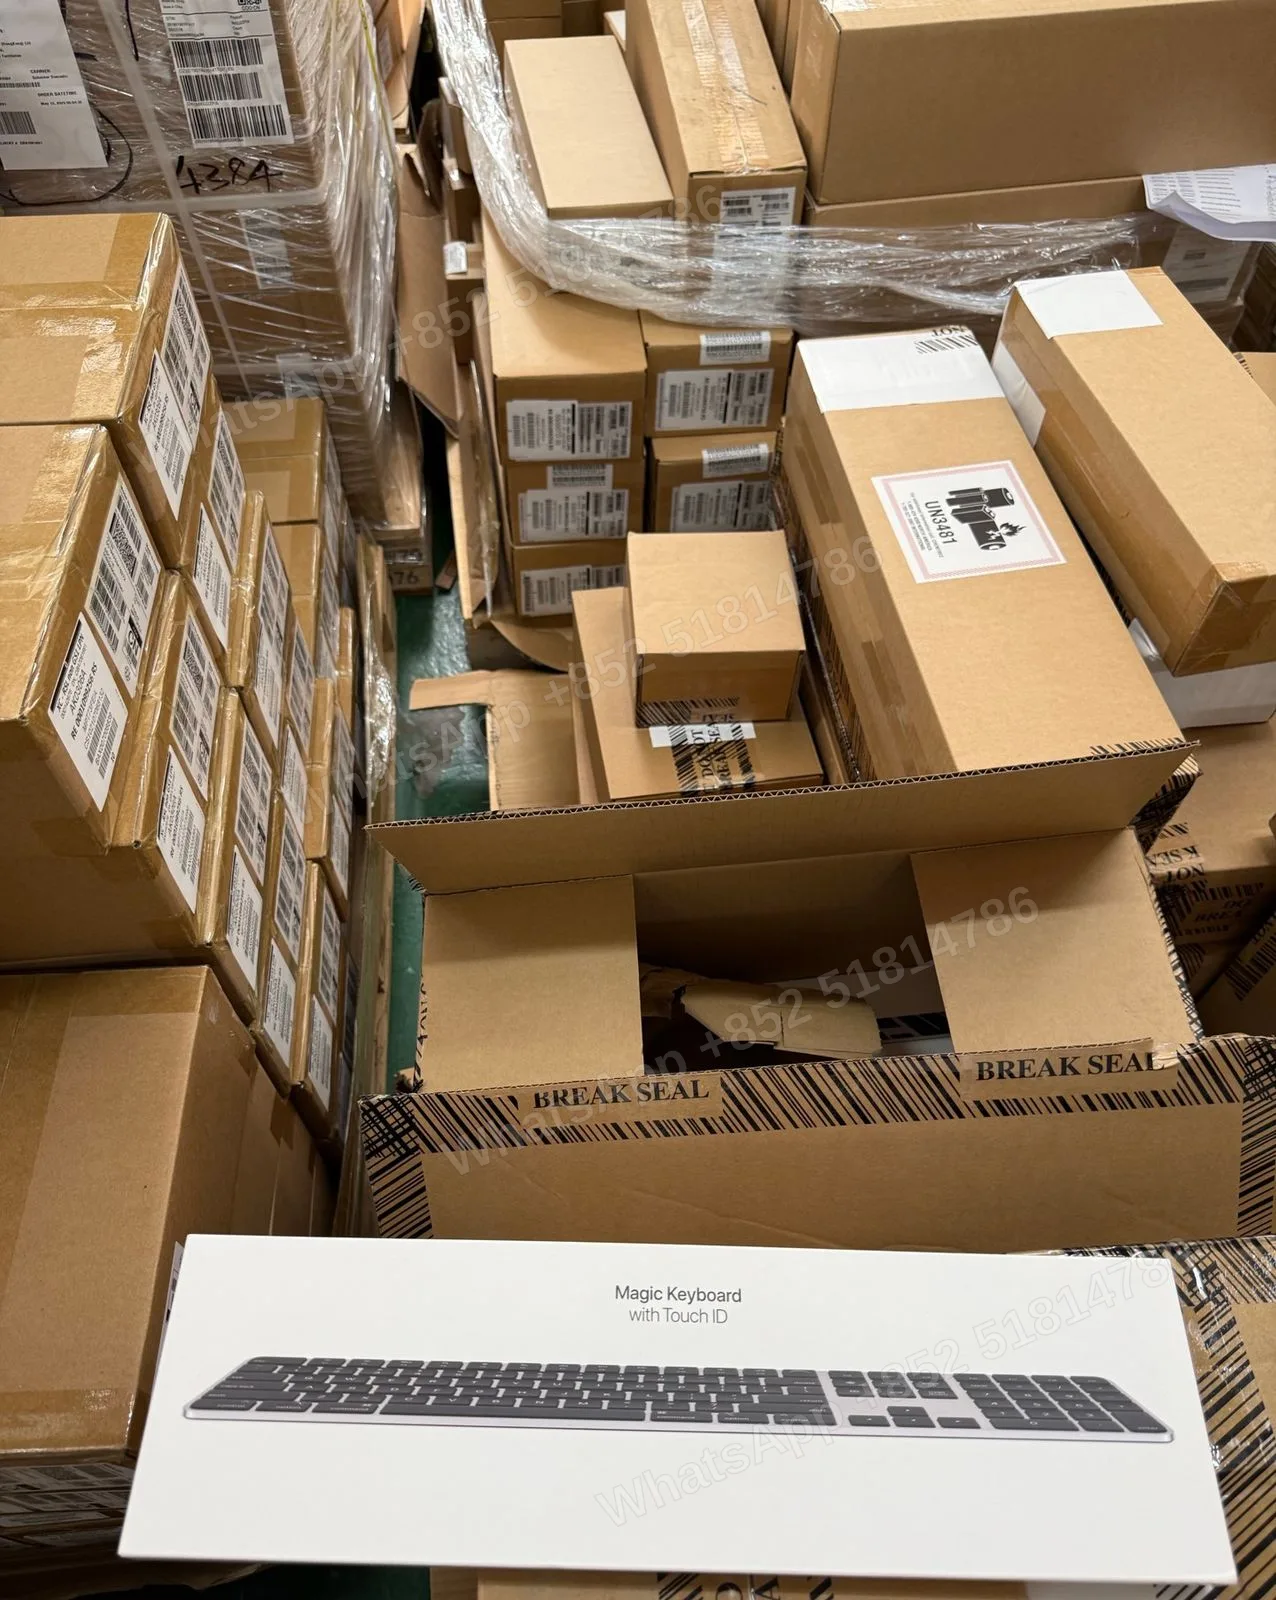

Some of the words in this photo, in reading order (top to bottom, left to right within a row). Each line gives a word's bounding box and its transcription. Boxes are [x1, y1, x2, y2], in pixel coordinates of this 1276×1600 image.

[925, 500, 958, 544] UN3481
[975, 1056, 1081, 1081] BREAK
[533, 1083, 632, 1109] BREAK
[637, 1079, 710, 1103] SEAL
[615, 1285, 663, 1304] Magic
[667, 1286, 742, 1305] Keyboard
[629, 1307, 660, 1322] with
[662, 1307, 709, 1323] Touch
[712, 1308, 729, 1324] ID
